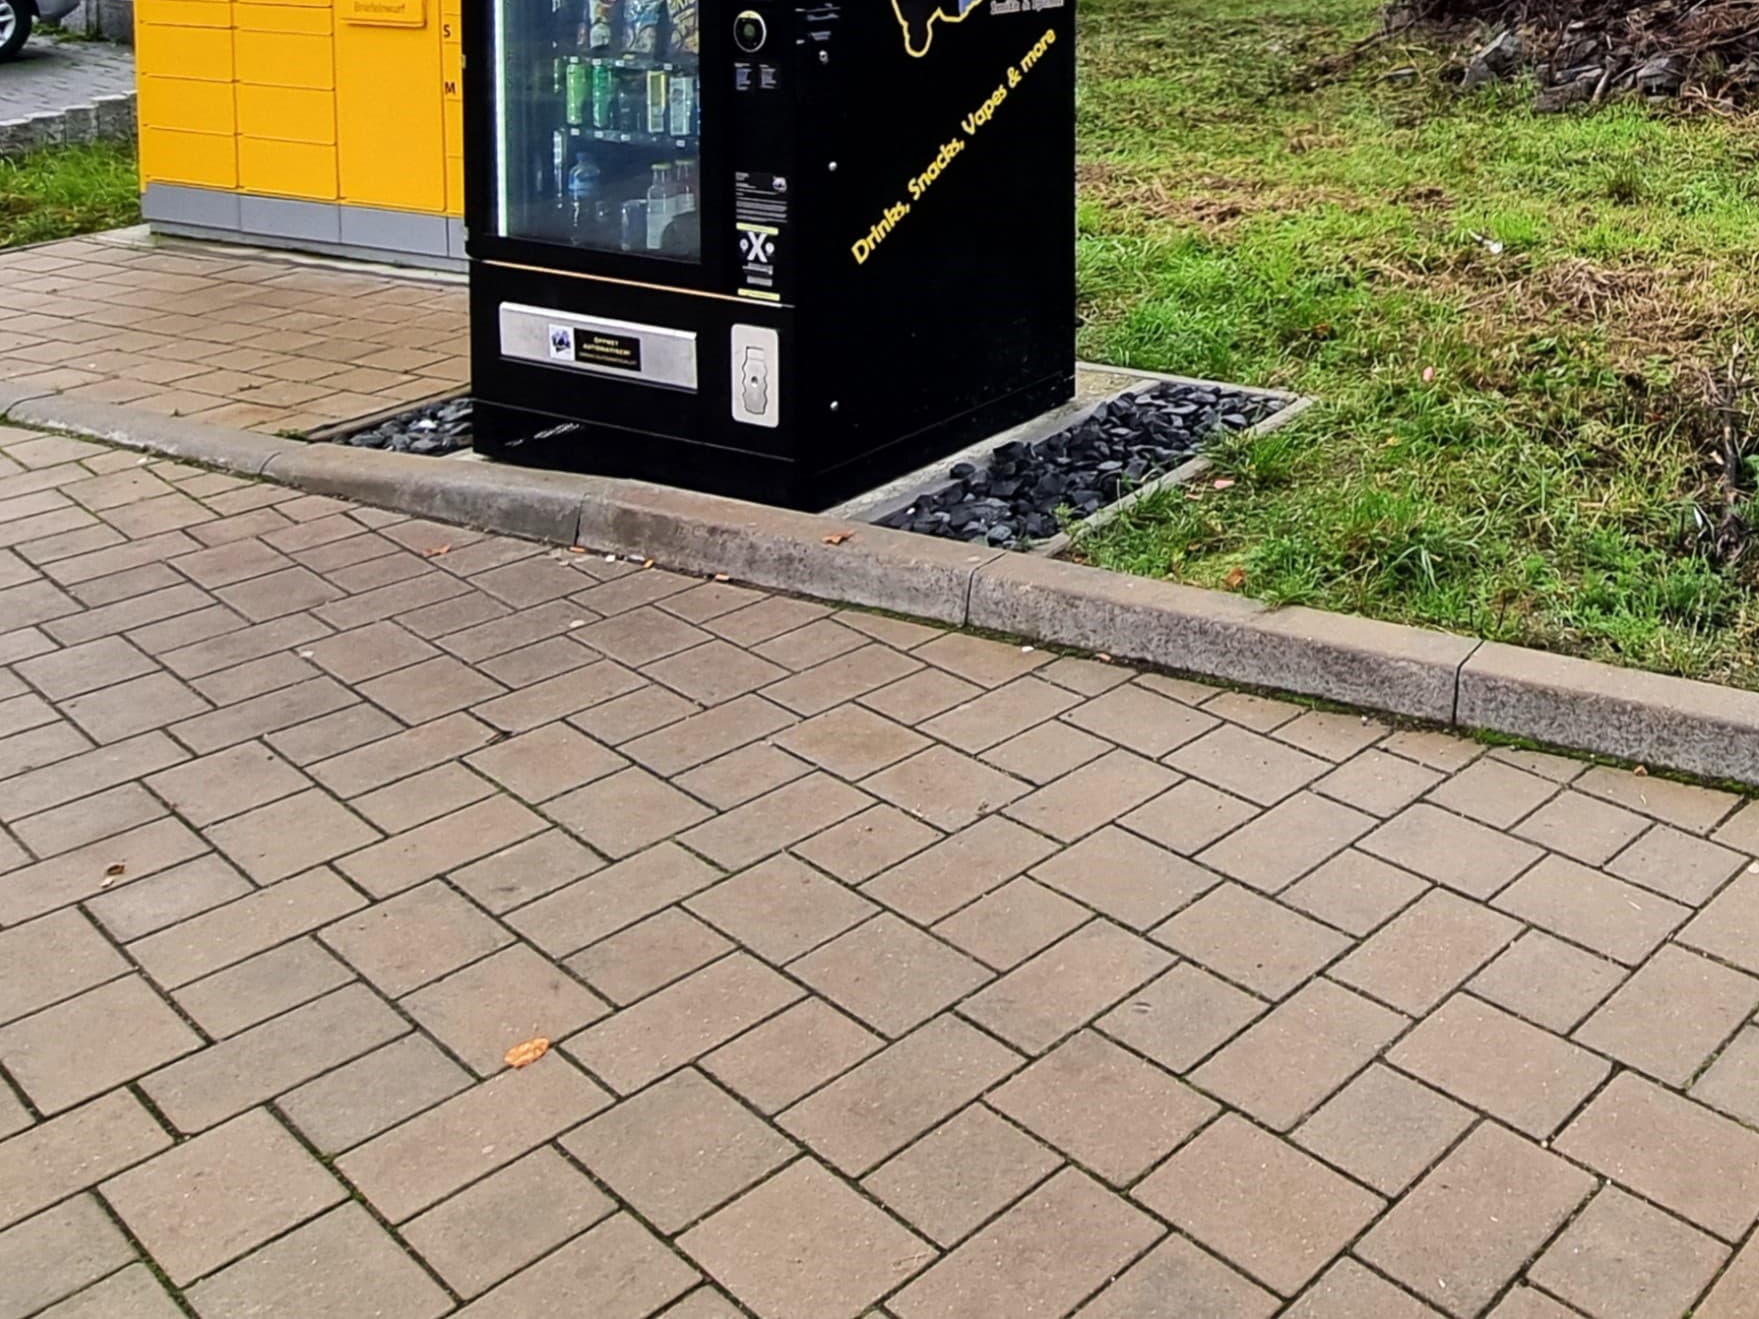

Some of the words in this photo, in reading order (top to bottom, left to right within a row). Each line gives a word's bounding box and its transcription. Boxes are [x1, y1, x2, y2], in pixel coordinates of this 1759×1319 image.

[443, 24, 450, 38] S
[445, 82, 456, 95] M
[851, 201, 910, 264] Drinks,
[908, 138, 964, 200] Snacks,
[961, 84, 1008, 135] Vapes
[1006, 66, 1022, 88] &
[1020, 29, 1056, 72] more
